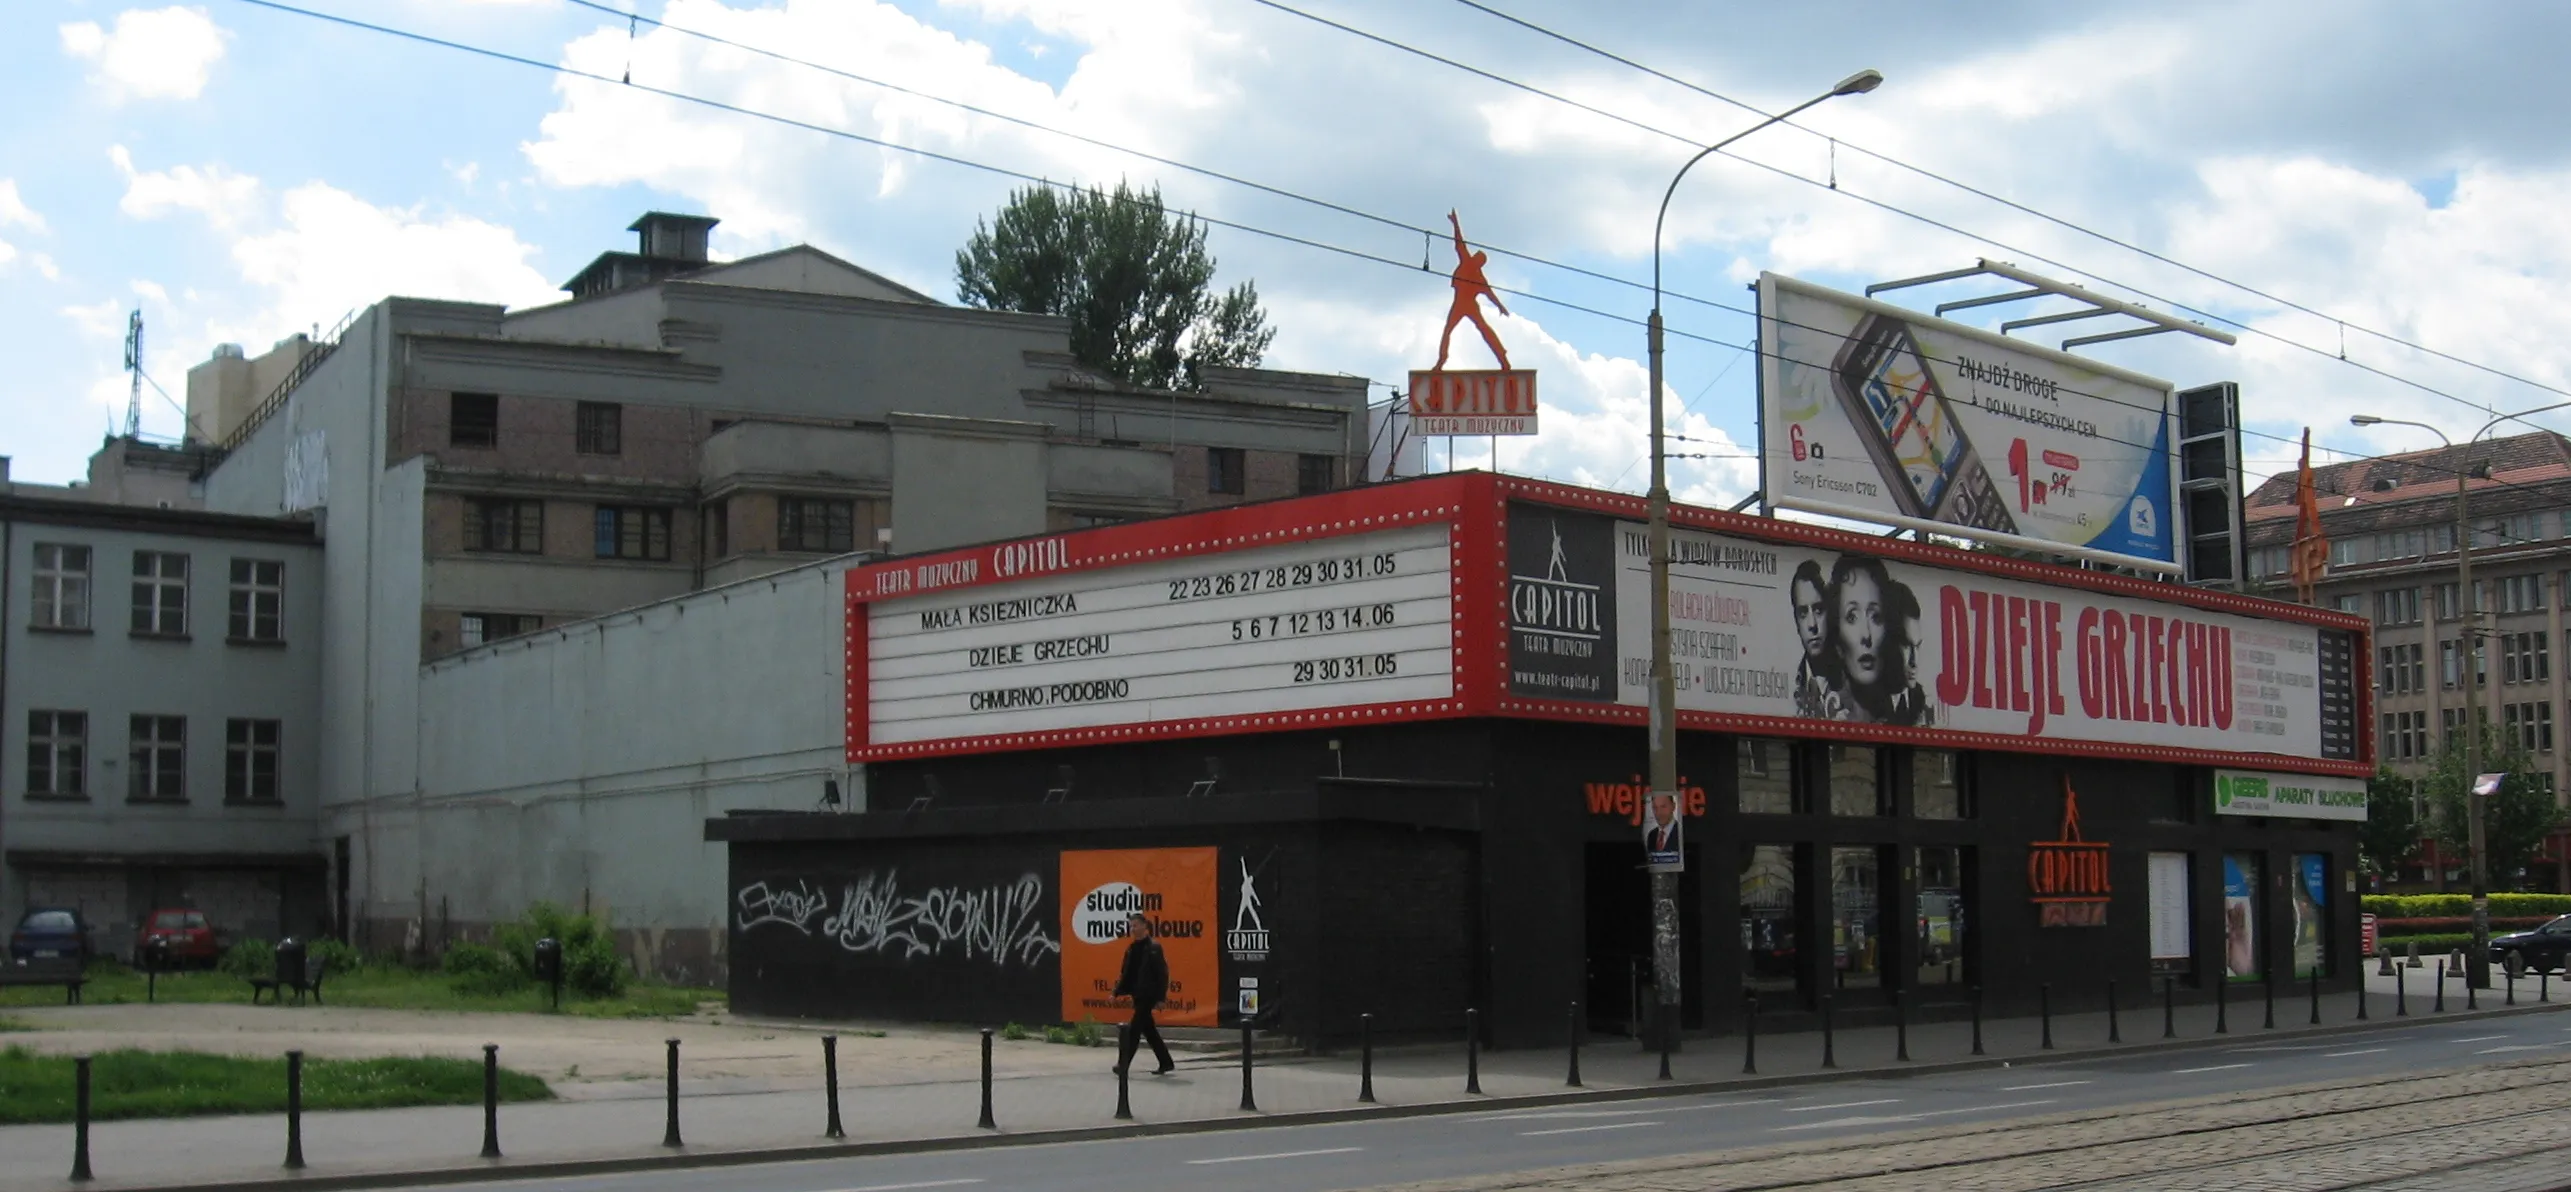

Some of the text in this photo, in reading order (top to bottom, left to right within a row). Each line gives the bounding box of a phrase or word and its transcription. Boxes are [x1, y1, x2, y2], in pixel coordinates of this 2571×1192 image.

[1409, 376, 1537, 413] CAPITOL
[1958, 355, 2059, 407] ZNAJDŹ DROGĘ
[1424, 418, 1525, 434] TEATR MUZYCZNY
[1986, 397, 2097, 438] DO NAJLEPSZYCH CEN
[1793, 470, 1816, 489] Sony
[1817, 474, 1854, 493] Ericsson
[2008, 437, 2029, 515] 1
[876, 539, 1069, 596] TEATR MUZYCZNY CAPITOL
[921, 610, 963, 630] MAŁA
[1169, 581, 1188, 600] 22
[1192, 577, 1211, 597] 23
[1215, 575, 1235, 595] 26
[1241, 570, 1260, 592] 27
[1266, 567, 1286, 588] 28
[1291, 564, 1312, 586] 29
[1317, 560, 1338, 582] 30
[1512, 585, 1600, 631] CAPITOL
[969, 645, 1023, 667] DZIEJE
[1034, 634, 1110, 661] GRZECHU
[1232, 620, 1242, 640] 5
[1250, 618, 1261, 638] 6
[1269, 616, 1279, 636] 7
[1289, 614, 1309, 634] 12
[1316, 610, 1334, 631] 13
[1524, 634, 1549, 653] TEATR
[1294, 661, 1313, 682] 29
[1320, 659, 1339, 680] 30
[1936, 585, 2065, 736] DZIEJE
[2077, 606, 2233, 731] GRZECHU
[1585, 774, 1707, 826] wejie
[2028, 850, 2112, 893] CAPITOL
[1086, 885, 1163, 911] studium
[1086, 912, 1204, 938] musilowe
[1226, 932, 1270, 950] CAPITOL
